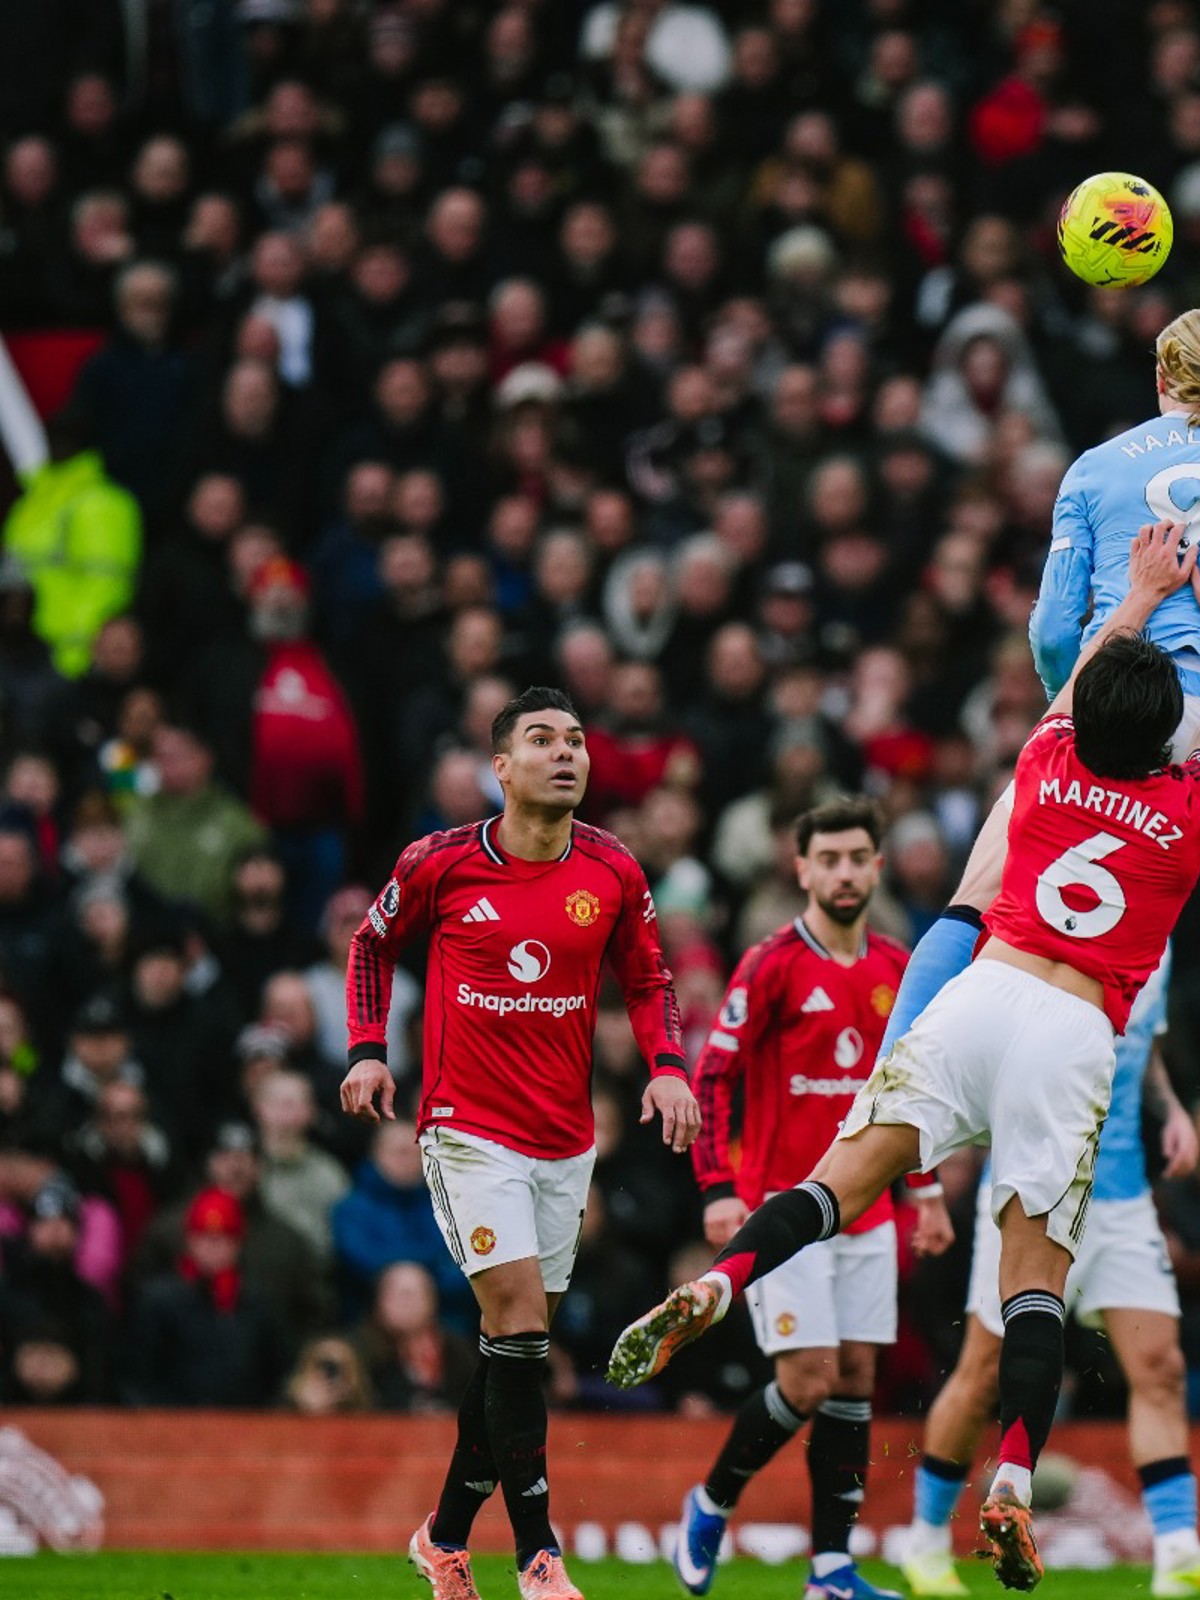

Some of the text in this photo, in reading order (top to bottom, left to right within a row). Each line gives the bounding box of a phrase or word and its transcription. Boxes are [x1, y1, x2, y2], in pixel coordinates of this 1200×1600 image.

[1038, 778, 1185, 850] MARTINEZ
[1035, 831, 1128, 939] 6
[456, 983, 587, 1018] Snapdragon
